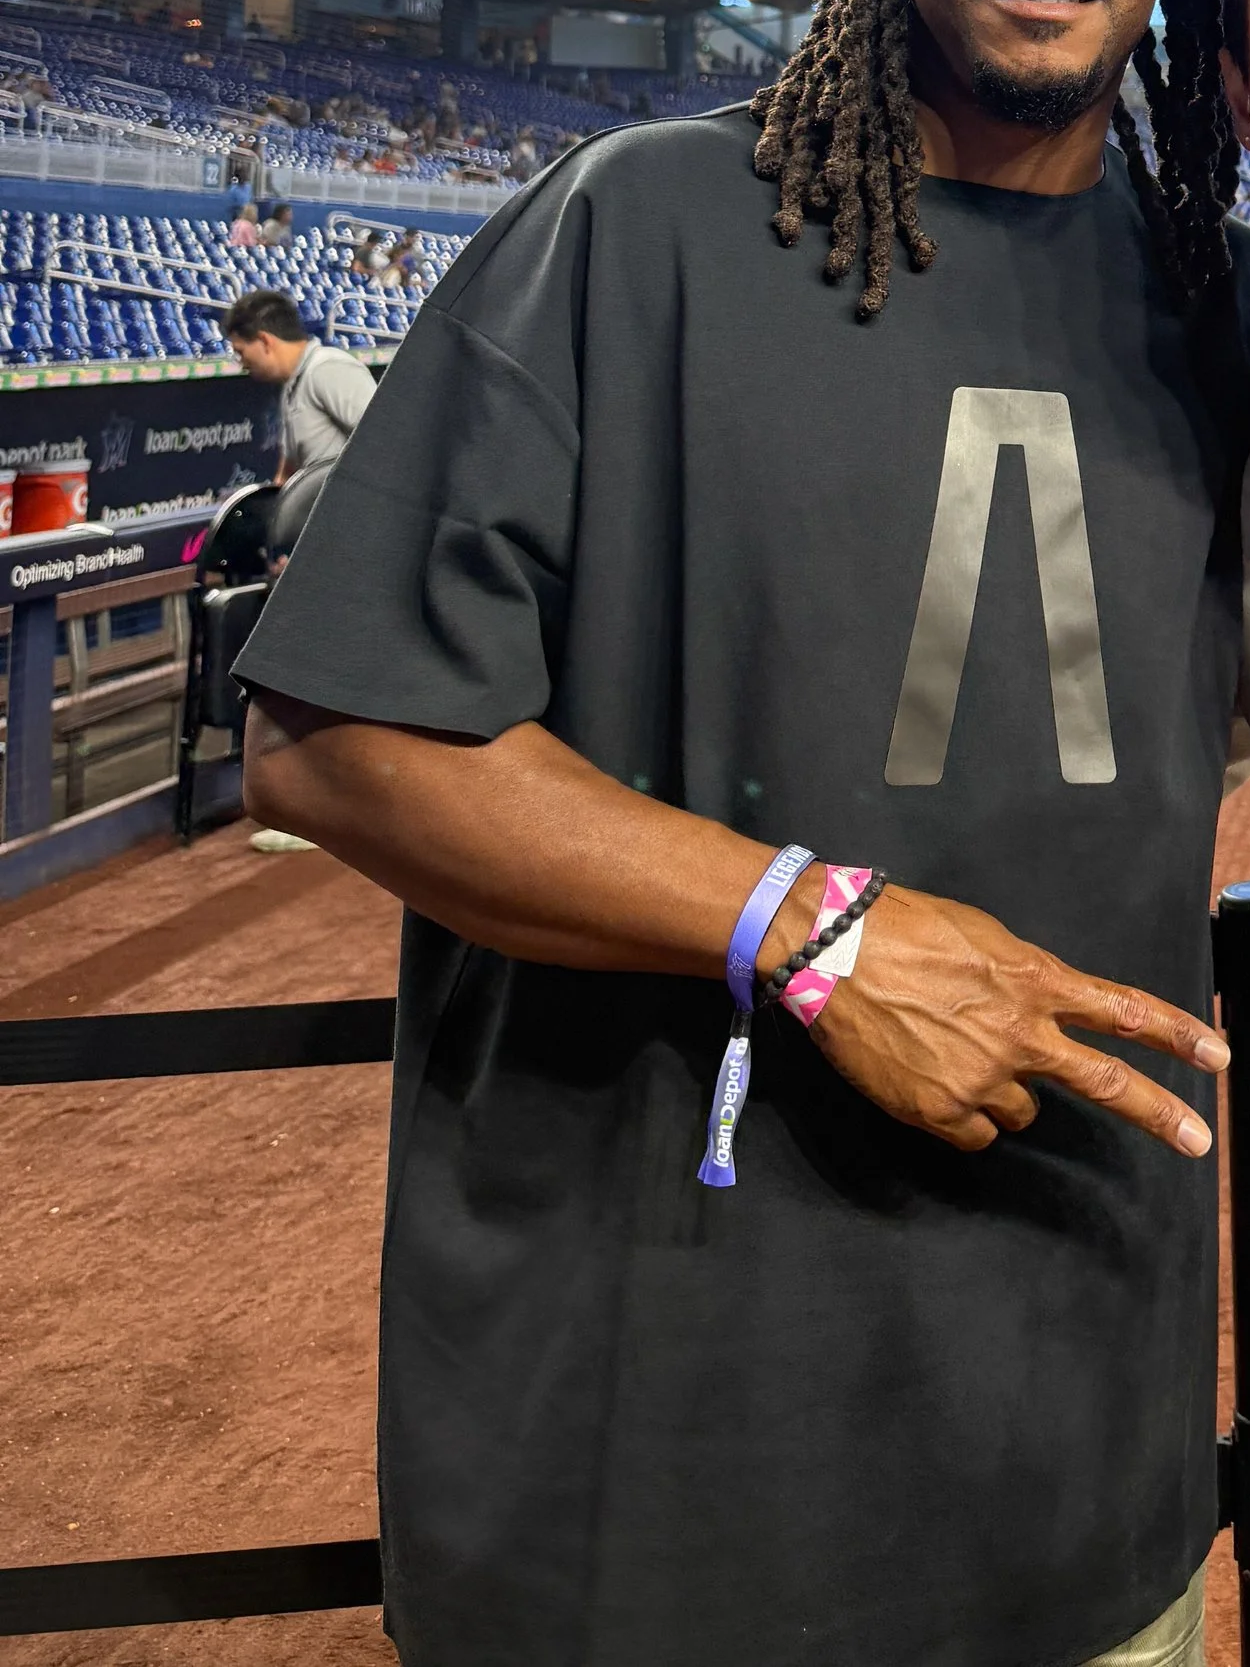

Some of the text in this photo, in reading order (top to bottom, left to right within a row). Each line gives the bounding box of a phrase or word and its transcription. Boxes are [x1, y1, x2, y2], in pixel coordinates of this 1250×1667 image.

[144, 418, 254, 455] loanDepot park
[10, 558, 75, 590] Optimizing
[713, 1058, 744, 1168] loanDepot
